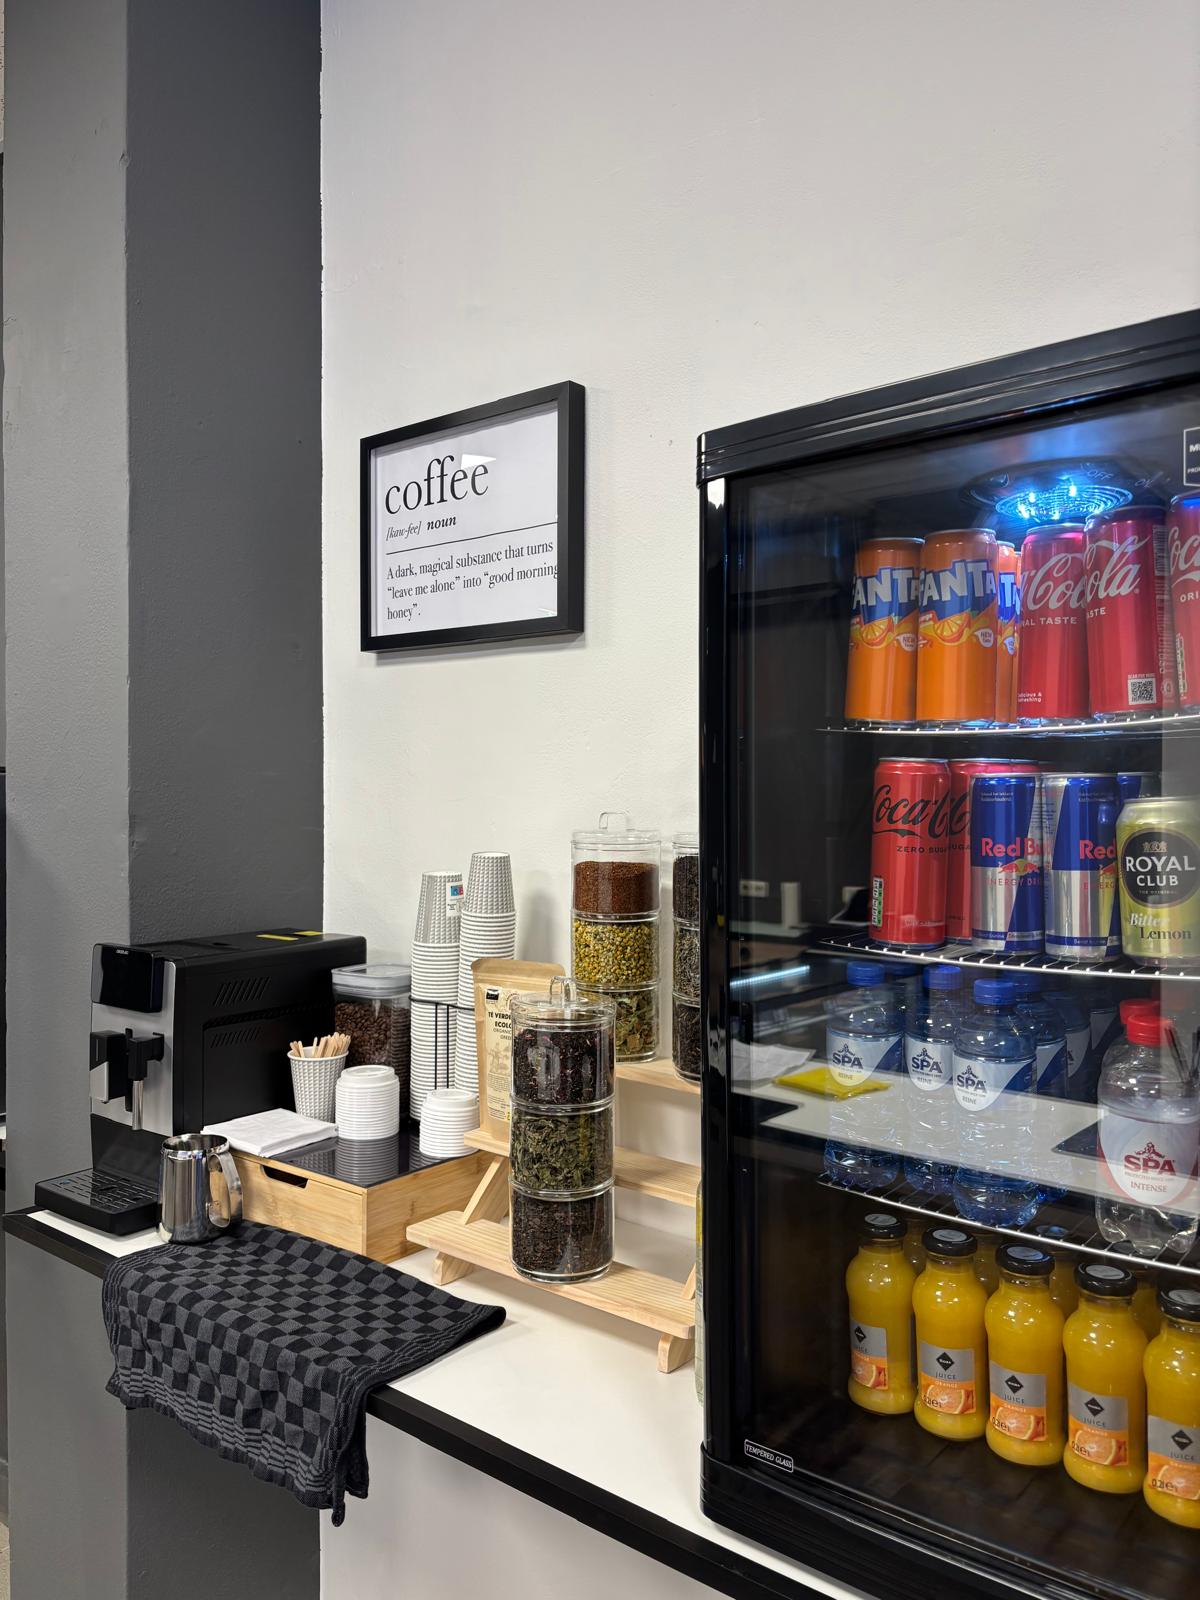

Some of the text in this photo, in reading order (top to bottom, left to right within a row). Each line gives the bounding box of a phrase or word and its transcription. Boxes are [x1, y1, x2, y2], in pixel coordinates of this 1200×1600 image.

[385, 455, 489, 515] coffee
[427, 516, 457, 531] noun
[387, 541, 554, 580] A dark, magical substance that turns
[415, 584, 429, 596] me
[463, 575, 482, 589] into
[1040, 616, 1078, 625] TASTE
[897, 845, 925, 854] ZERO
[981, 837, 1021, 857] Red
[1079, 839, 1116, 860] Red
[1125, 855, 1197, 873] ROYAL
[1136, 875, 1179, 886] CLUB
[1140, 926, 1192, 940] Lemon
[832, 1052, 864, 1070] SPA
[912, 1056, 943, 1074] SPA
[957, 1074, 987, 1093] SPA
[1124, 1154, 1176, 1176] SPA
[1130, 1181, 1168, 1193] INTENSE
[935, 1371, 957, 1380] JUICE
[746, 1444, 792, 1468] TEMPERED GLASS
